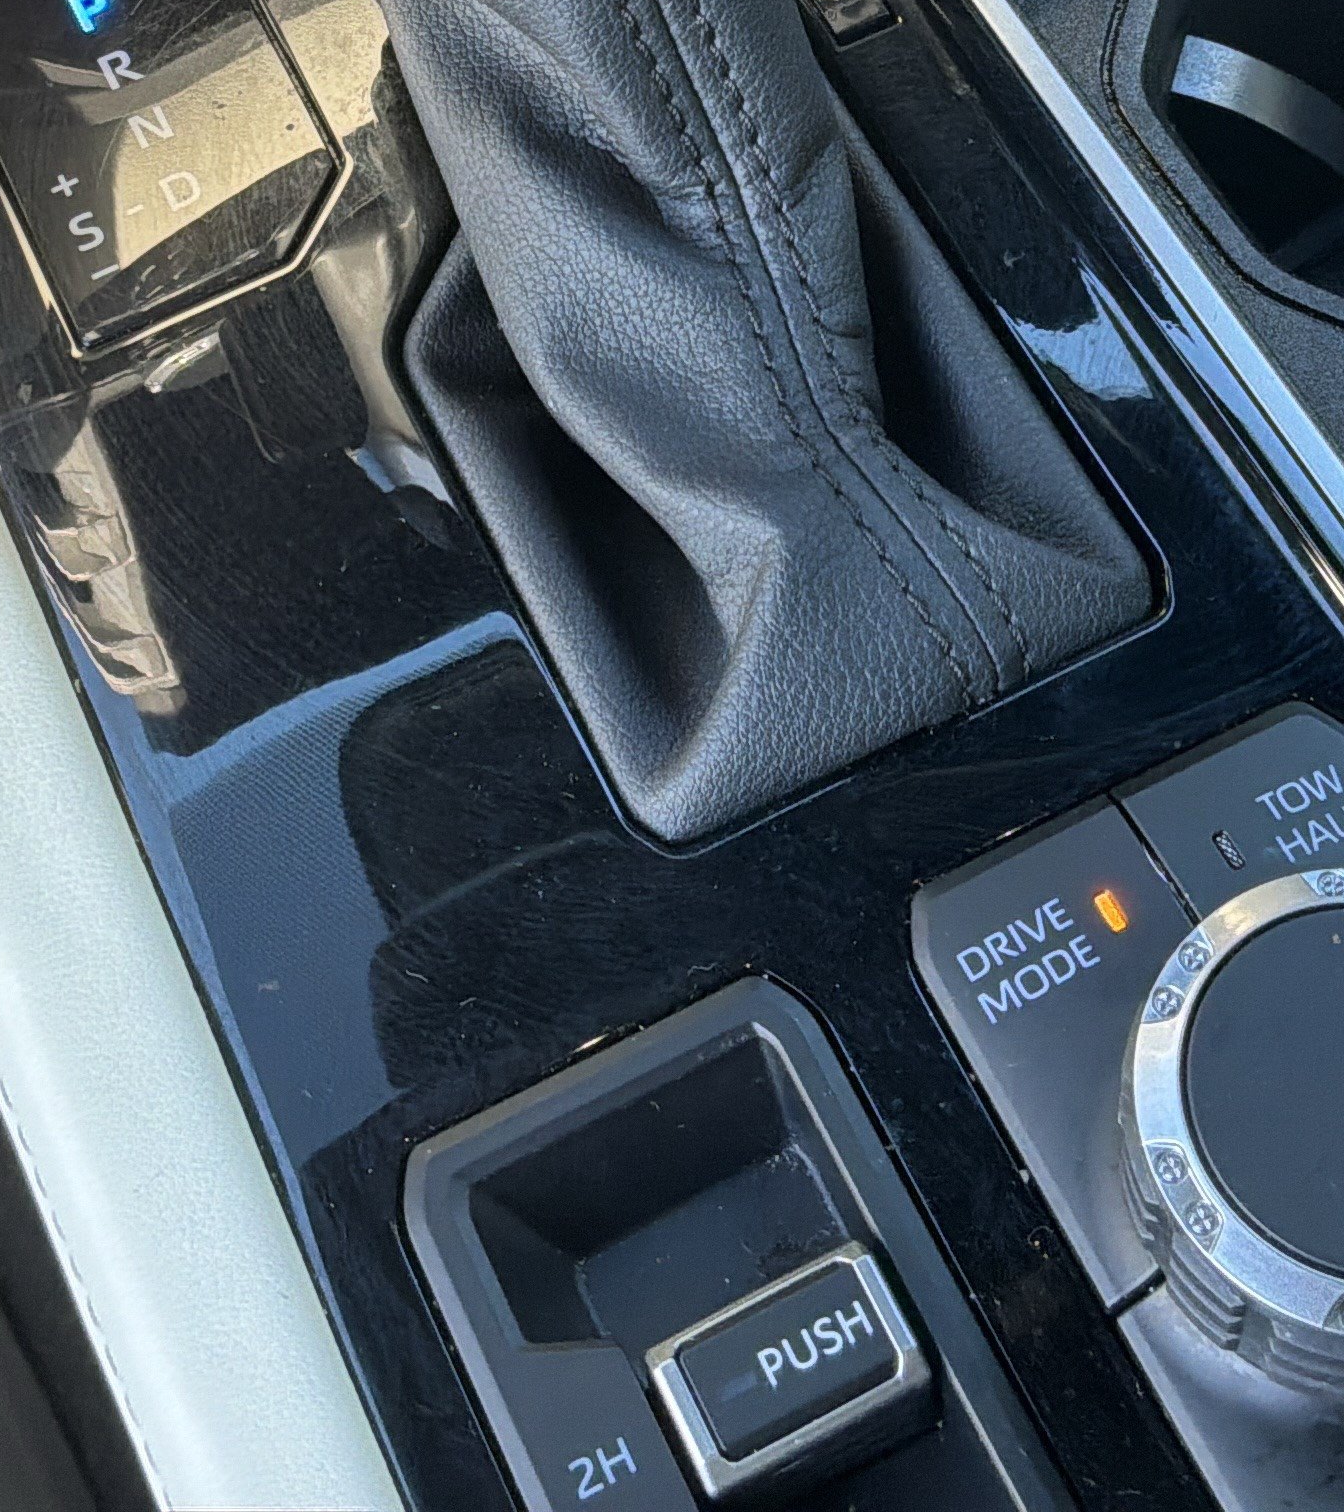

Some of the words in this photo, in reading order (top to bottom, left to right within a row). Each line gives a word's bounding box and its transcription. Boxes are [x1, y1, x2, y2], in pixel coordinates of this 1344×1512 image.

[97, 49, 144, 90] R
[127, 106, 175, 149] N
[158, 171, 201, 212] D
[68, 212, 106, 252] S
[1255, 764, 1344, 823] TOW
[956, 898, 1075, 983] DRIVE
[976, 934, 1102, 1026] MODE
[757, 1300, 874, 1388] PUSH
[567, 1436, 638, 1501] 2H
